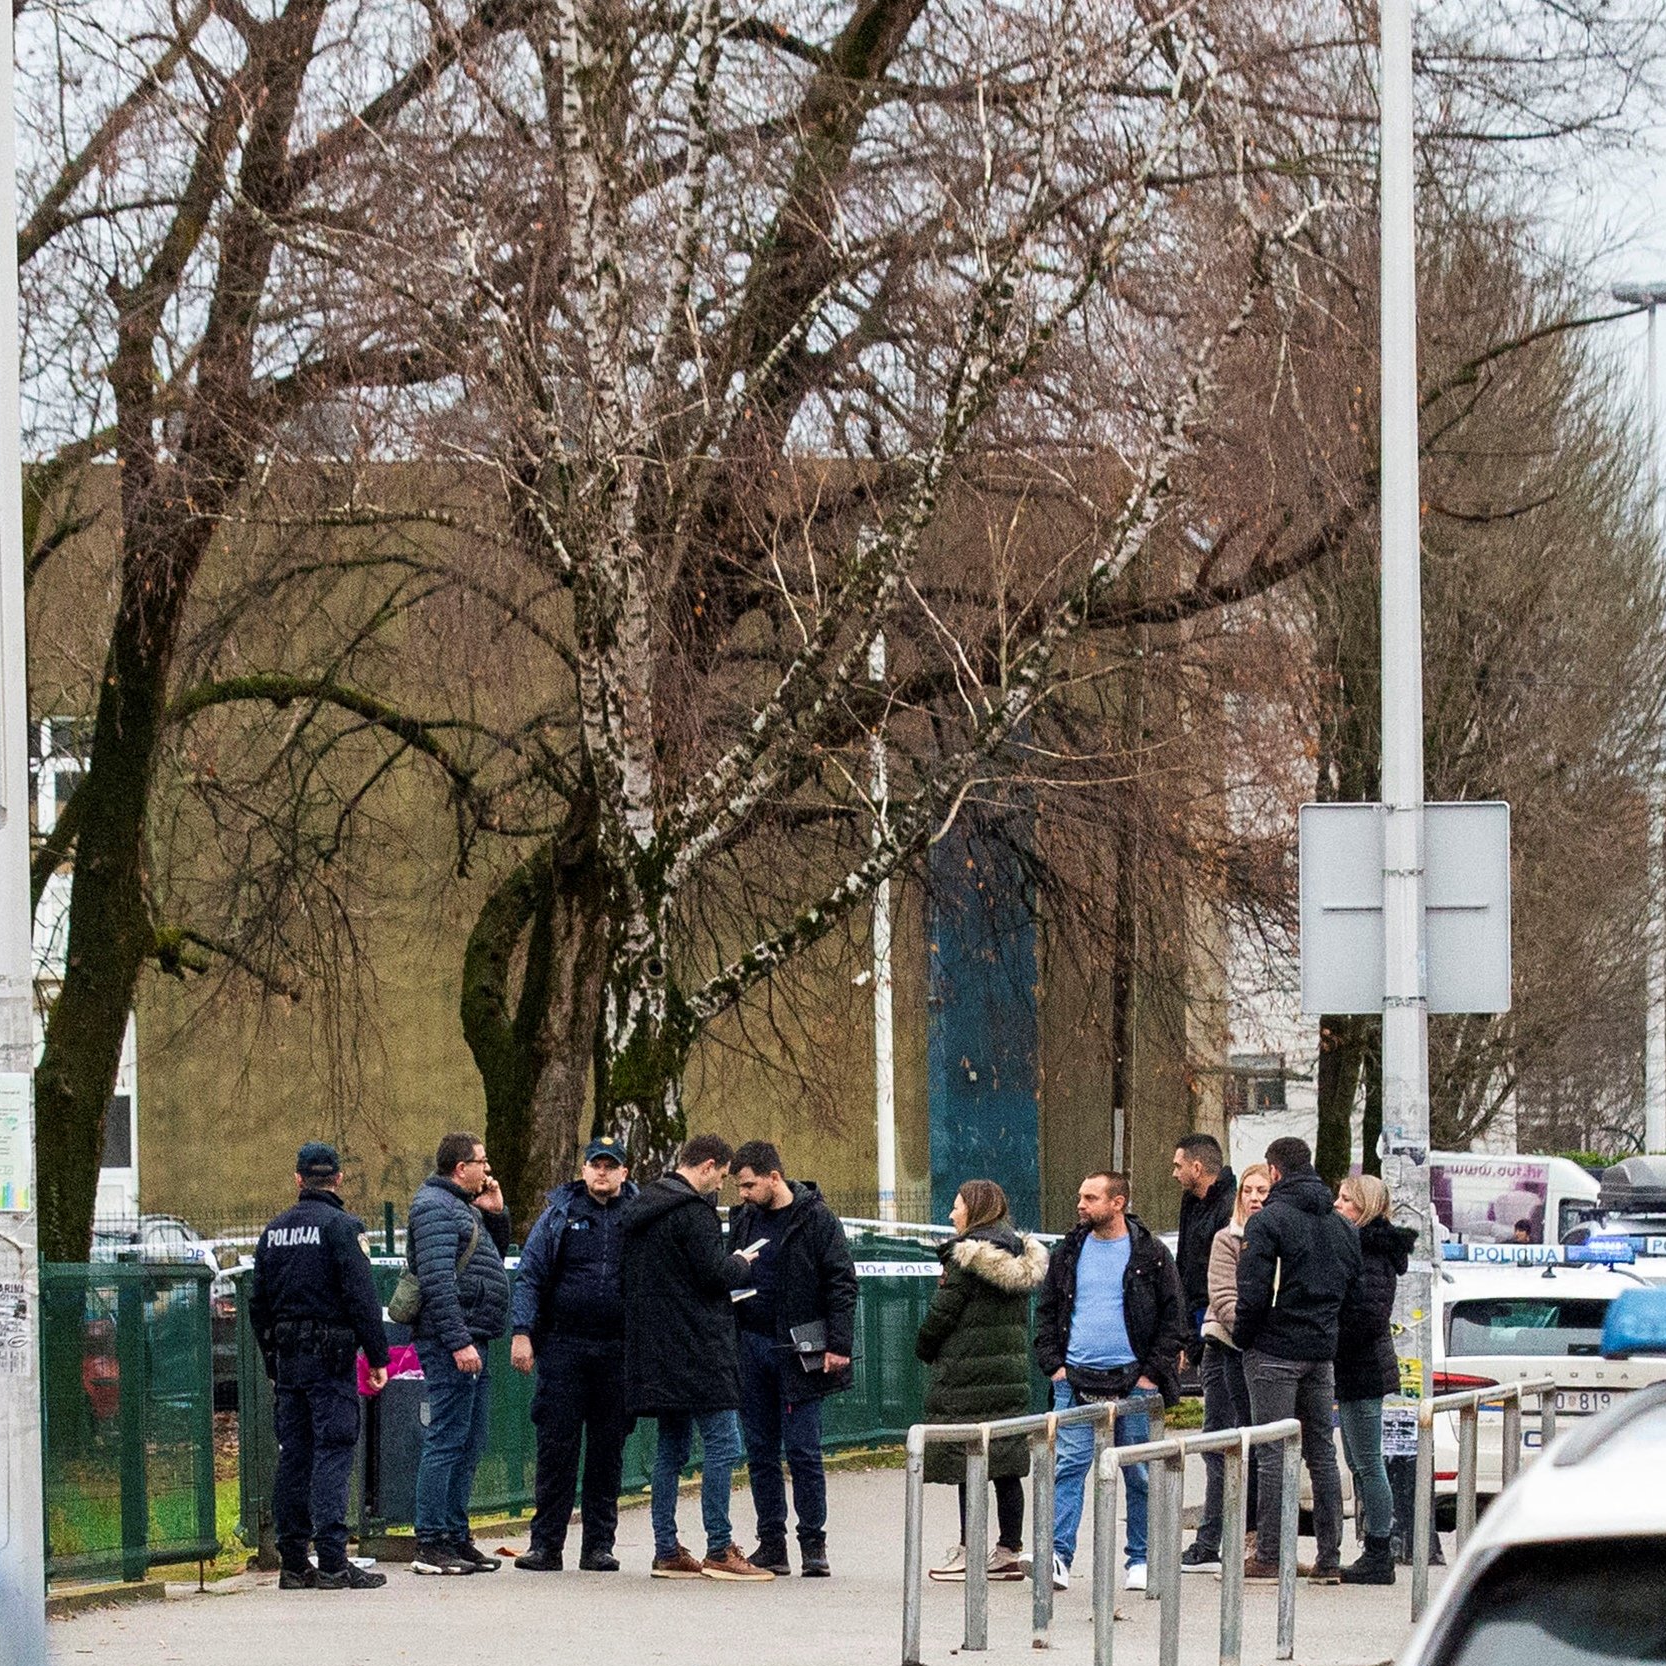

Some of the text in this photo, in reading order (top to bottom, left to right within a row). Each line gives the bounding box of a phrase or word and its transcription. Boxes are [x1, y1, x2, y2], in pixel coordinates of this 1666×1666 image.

[267, 1226, 321, 1248] POLICIJA
[1474, 1247, 1558, 1263] POLICIJA
[896, 1263, 933, 1274] STOP
[1537, 1393, 1611, 1411] 10 819
